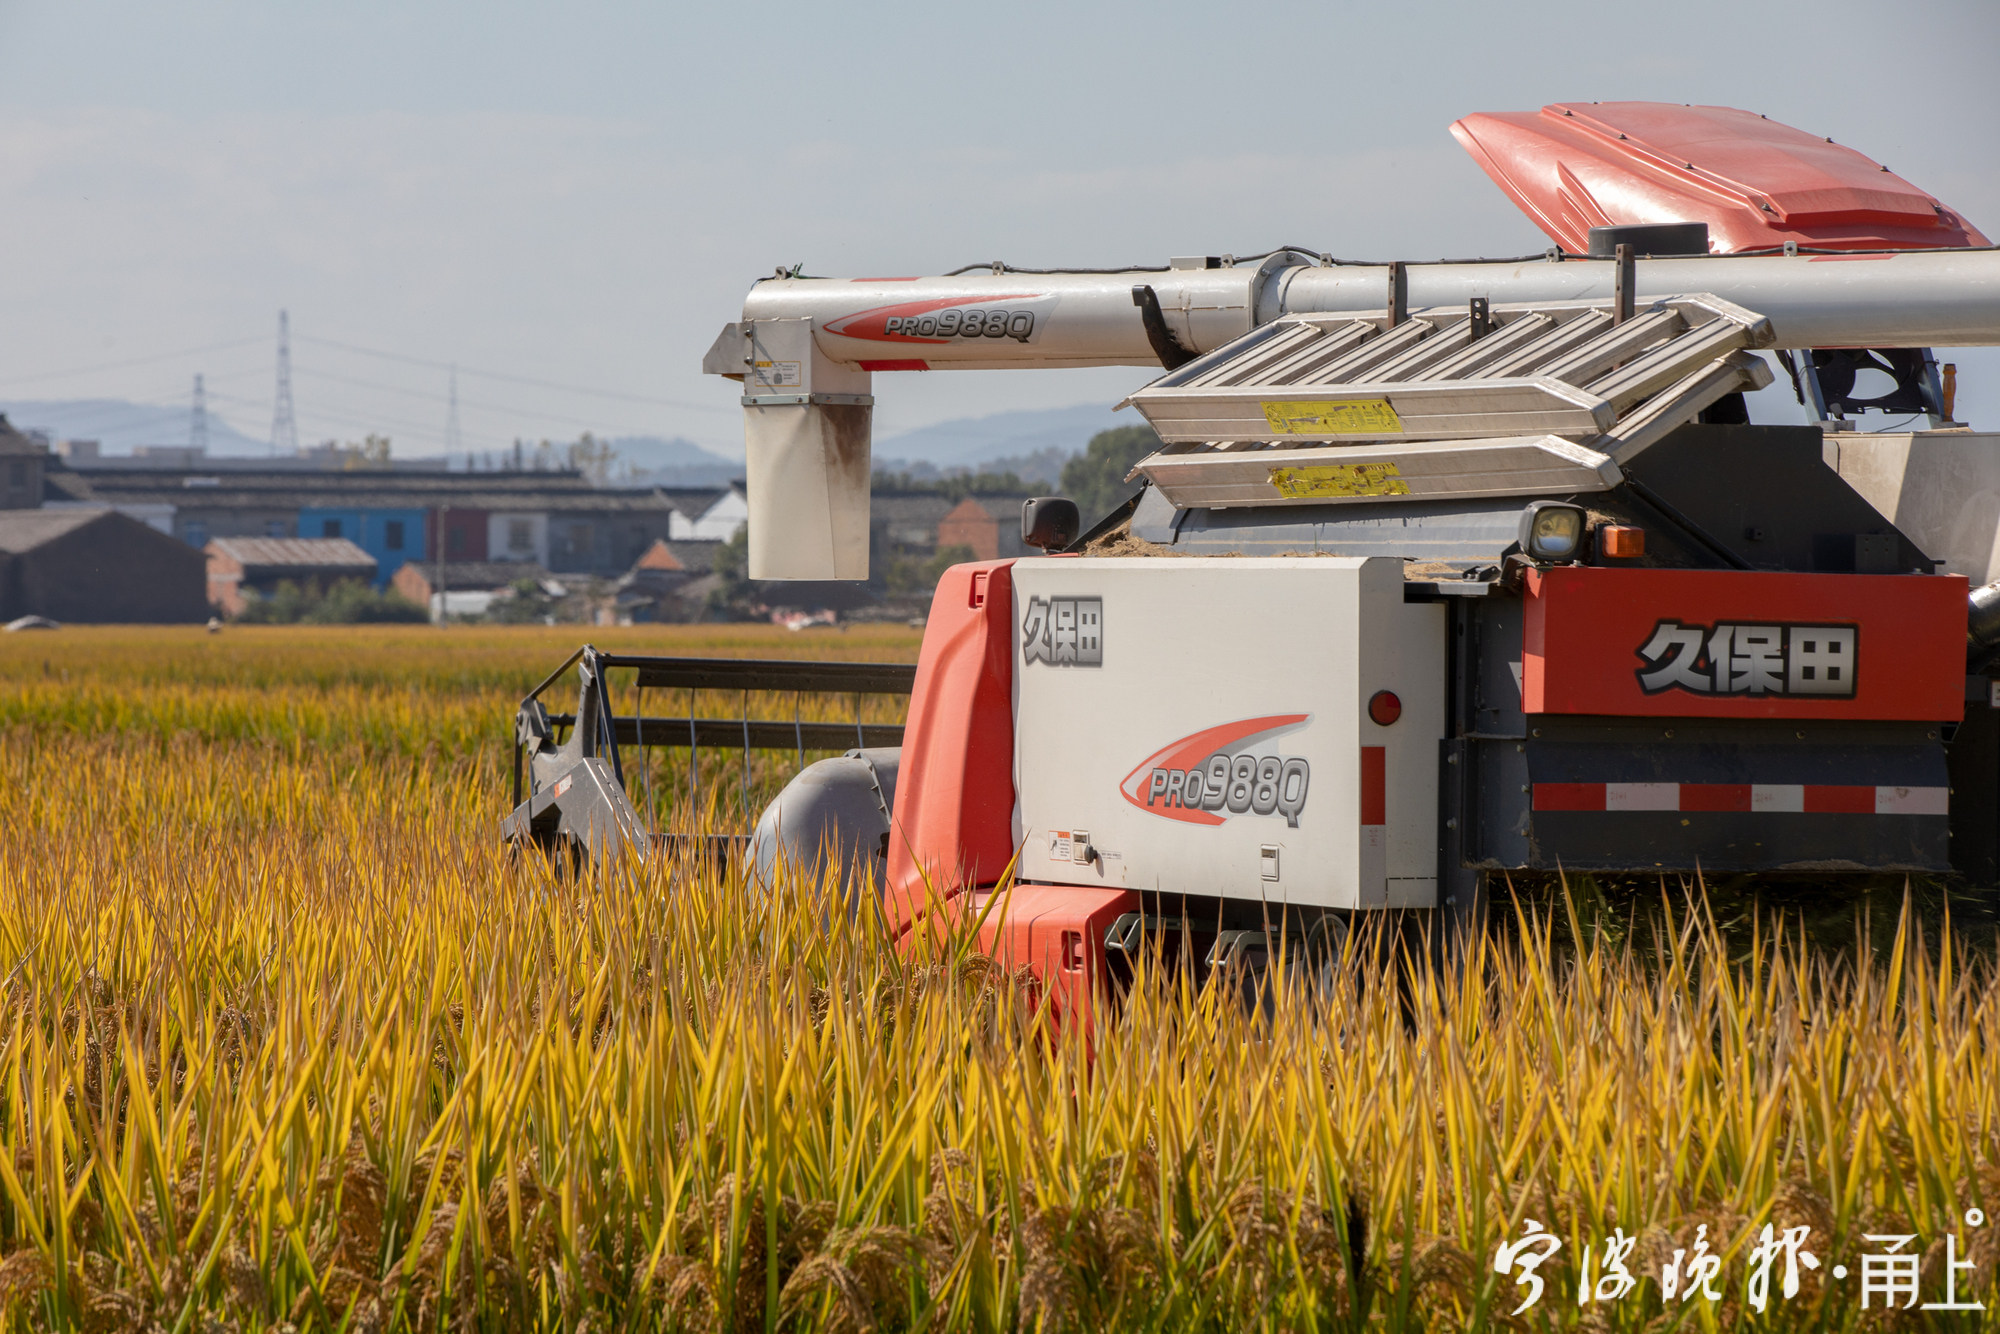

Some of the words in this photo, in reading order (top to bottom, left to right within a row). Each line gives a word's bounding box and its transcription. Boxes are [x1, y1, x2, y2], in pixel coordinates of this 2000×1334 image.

[884, 309, 1034, 343] PRO988Q
[1023, 595, 1103, 666] 久保田
[1636, 620, 1860, 699] 久保田
[1148, 754, 1309, 829] PRO988Q
